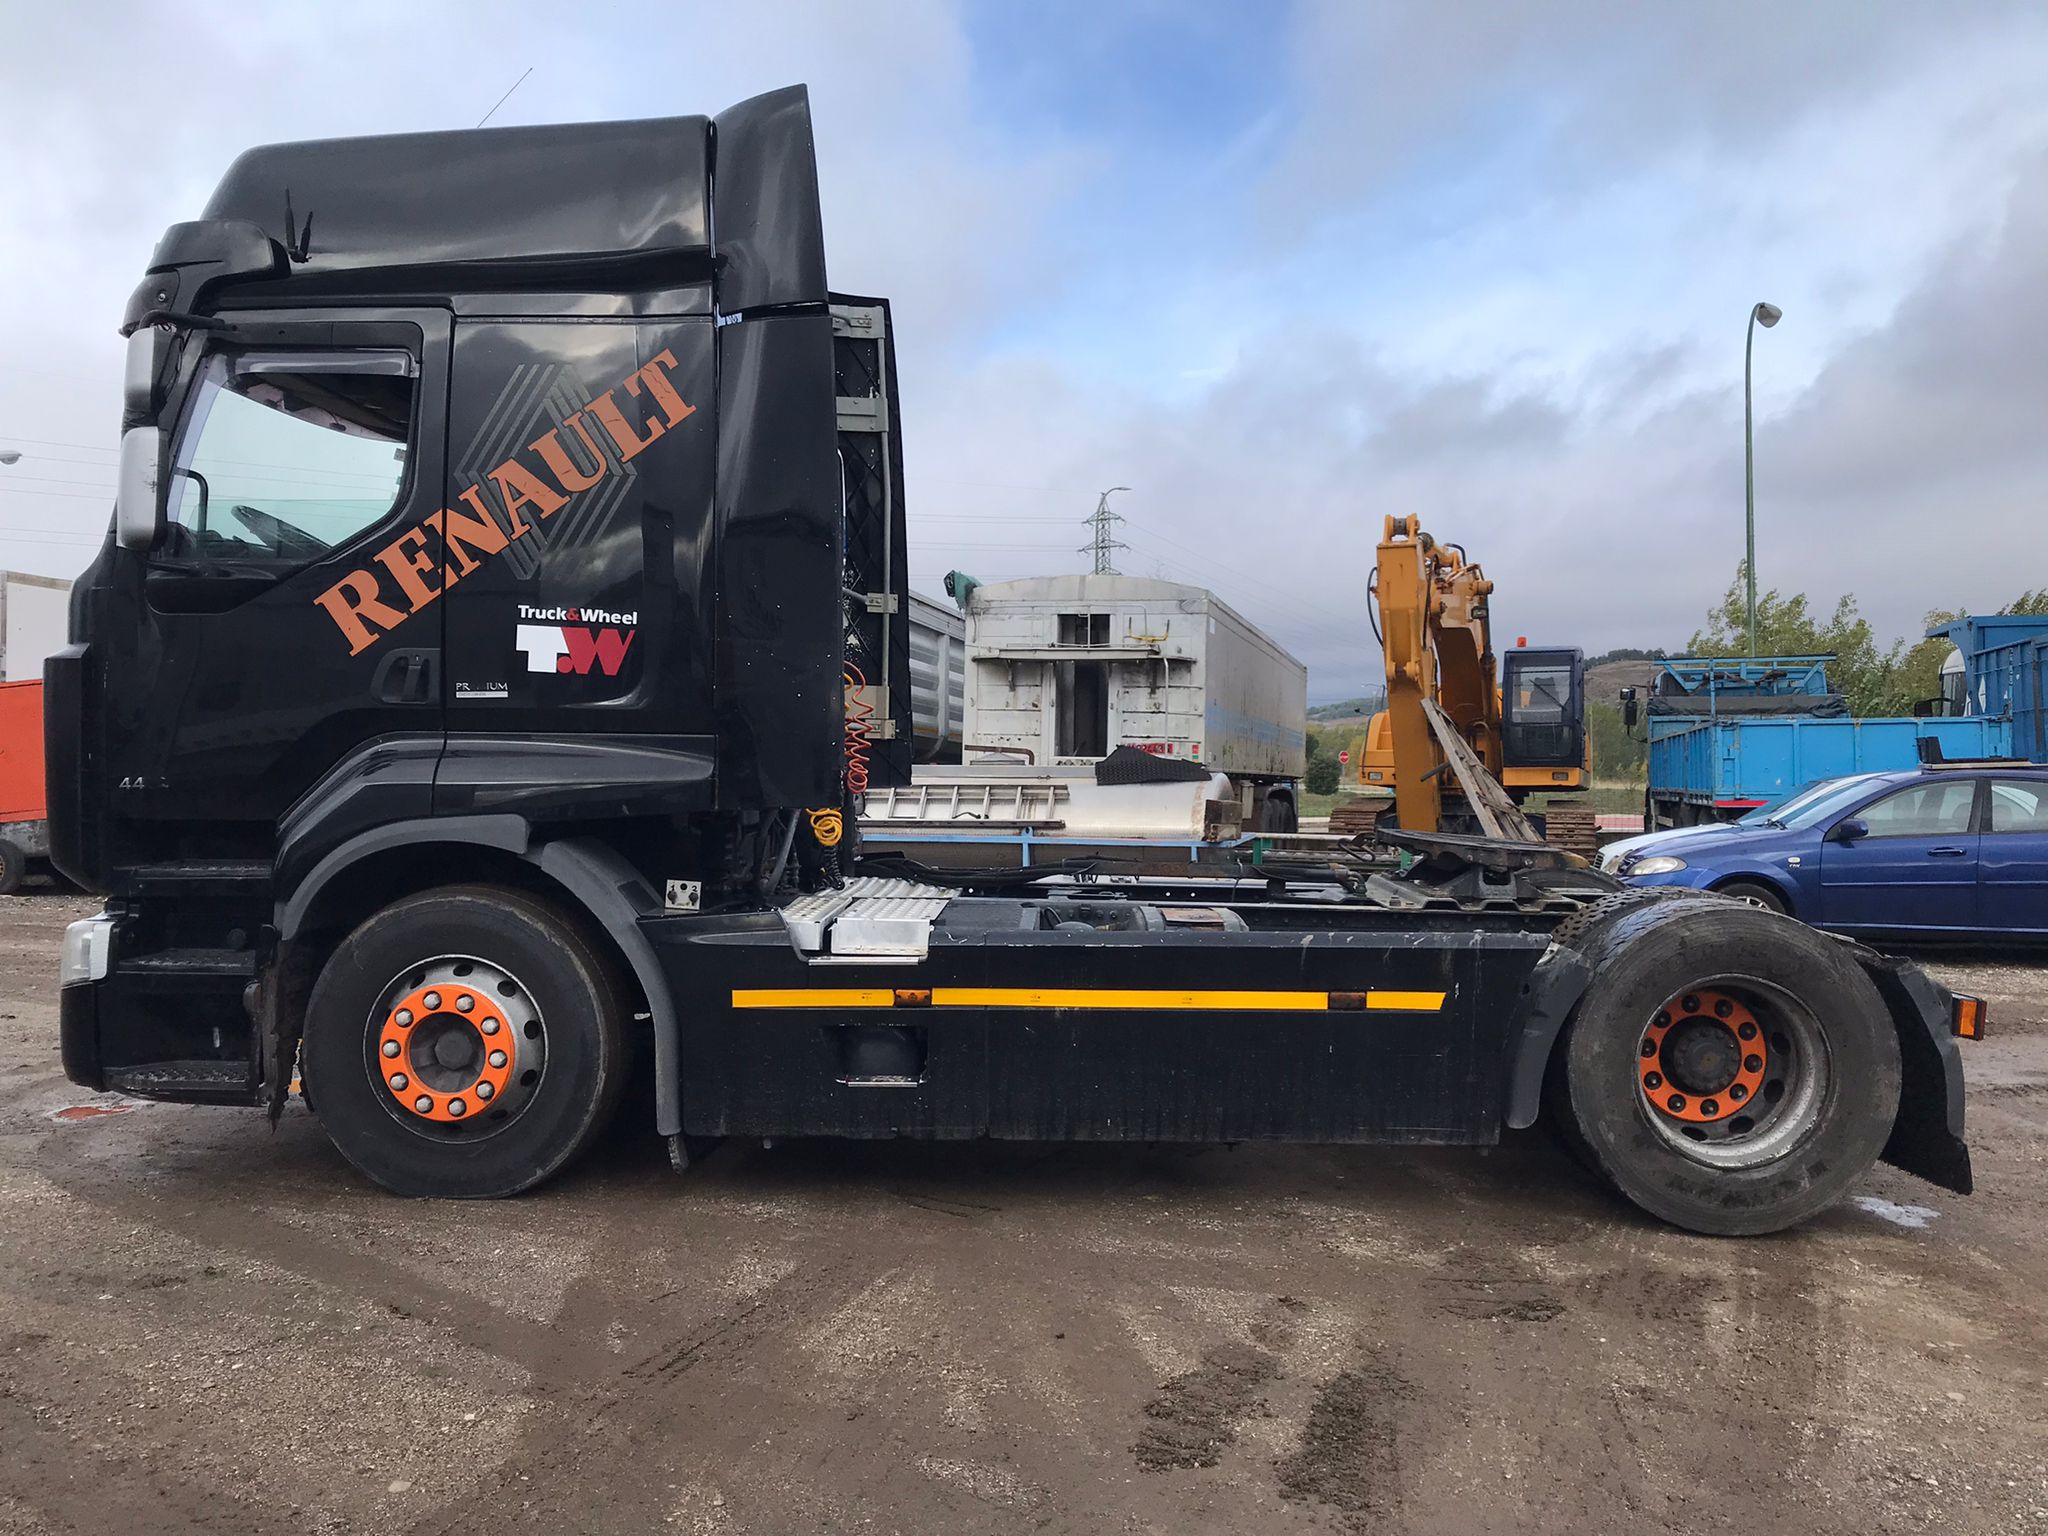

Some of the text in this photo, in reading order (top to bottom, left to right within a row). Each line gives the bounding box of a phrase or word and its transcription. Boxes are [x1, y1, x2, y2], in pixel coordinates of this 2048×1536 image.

[314, 348, 697, 656] RENAULT
[518, 605, 638, 625] Truck&Wheel
[456, 682, 508, 691] PRIUM
